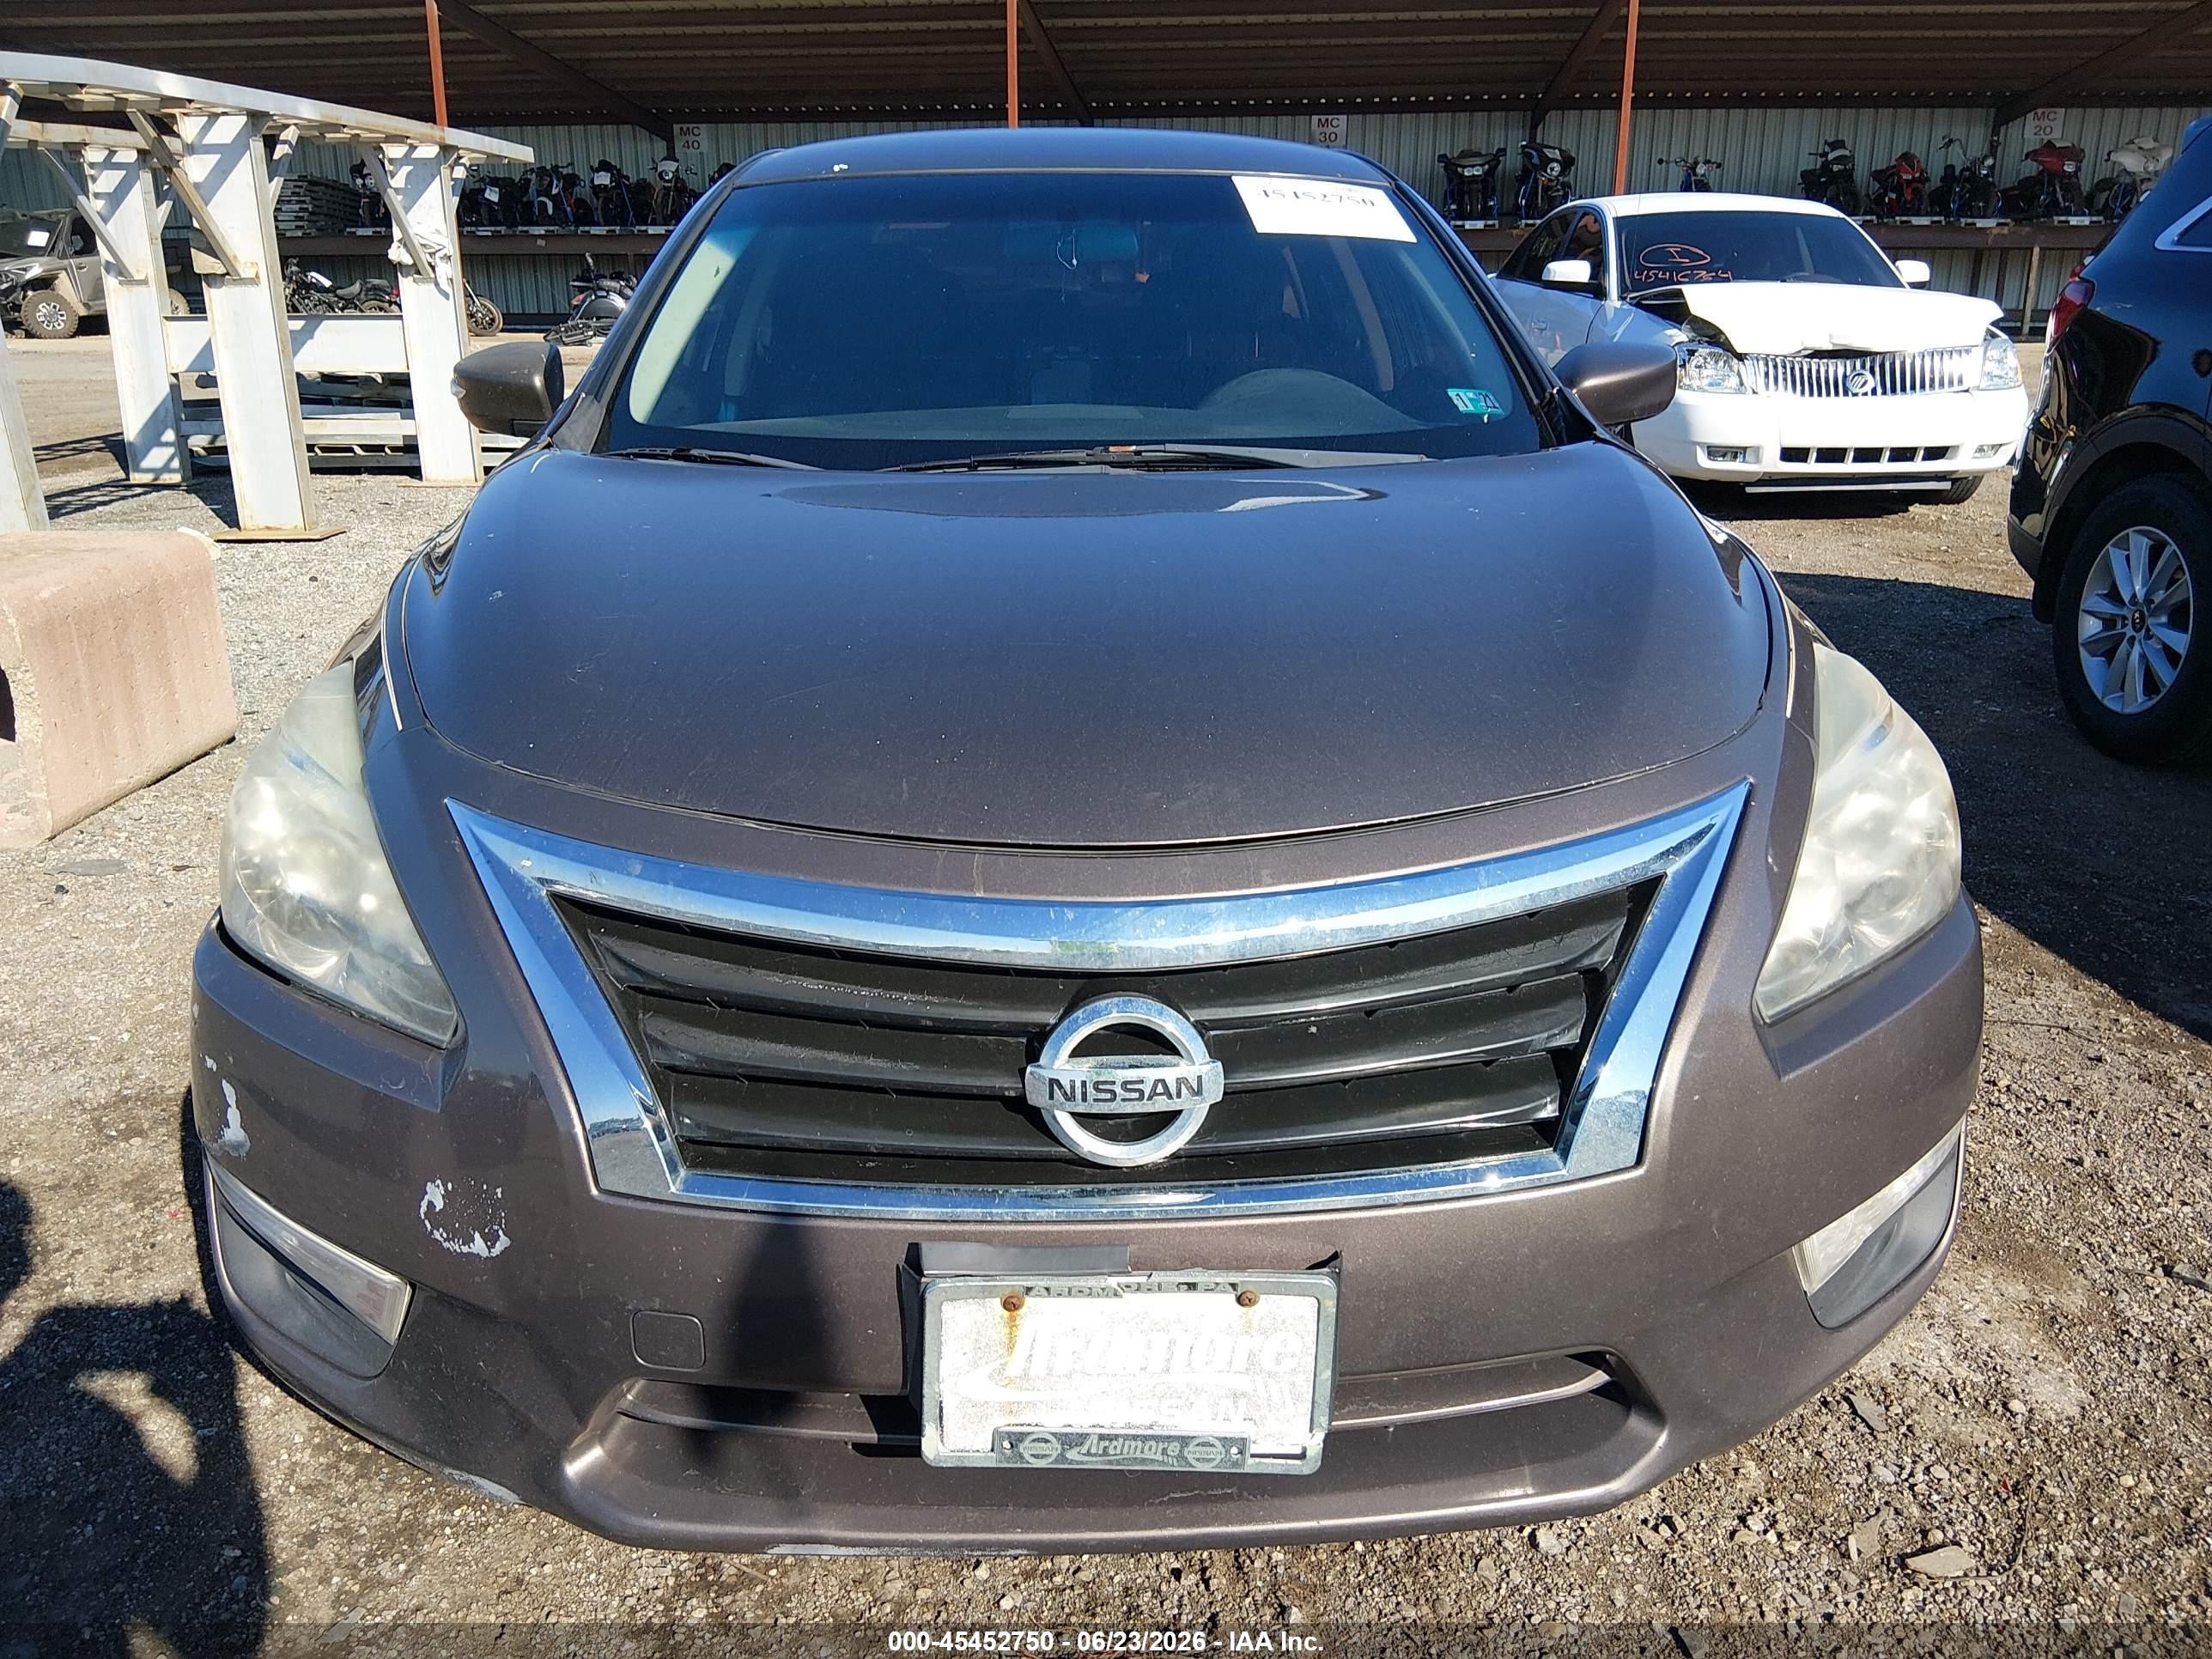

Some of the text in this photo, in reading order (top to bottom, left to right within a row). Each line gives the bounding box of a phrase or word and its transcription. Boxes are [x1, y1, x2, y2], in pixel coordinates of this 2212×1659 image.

[2033, 111, 2057, 122] MC
[1317, 117, 1340, 129] MC
[679, 126, 701, 137] MC
[2033, 125, 2053, 136] 20
[1318, 131, 1338, 143] 30
[682, 140, 701, 150] 40
[1048, 1075, 1203, 1103] NISSAN
[1079, 1434, 1180, 1456] Ardmore
